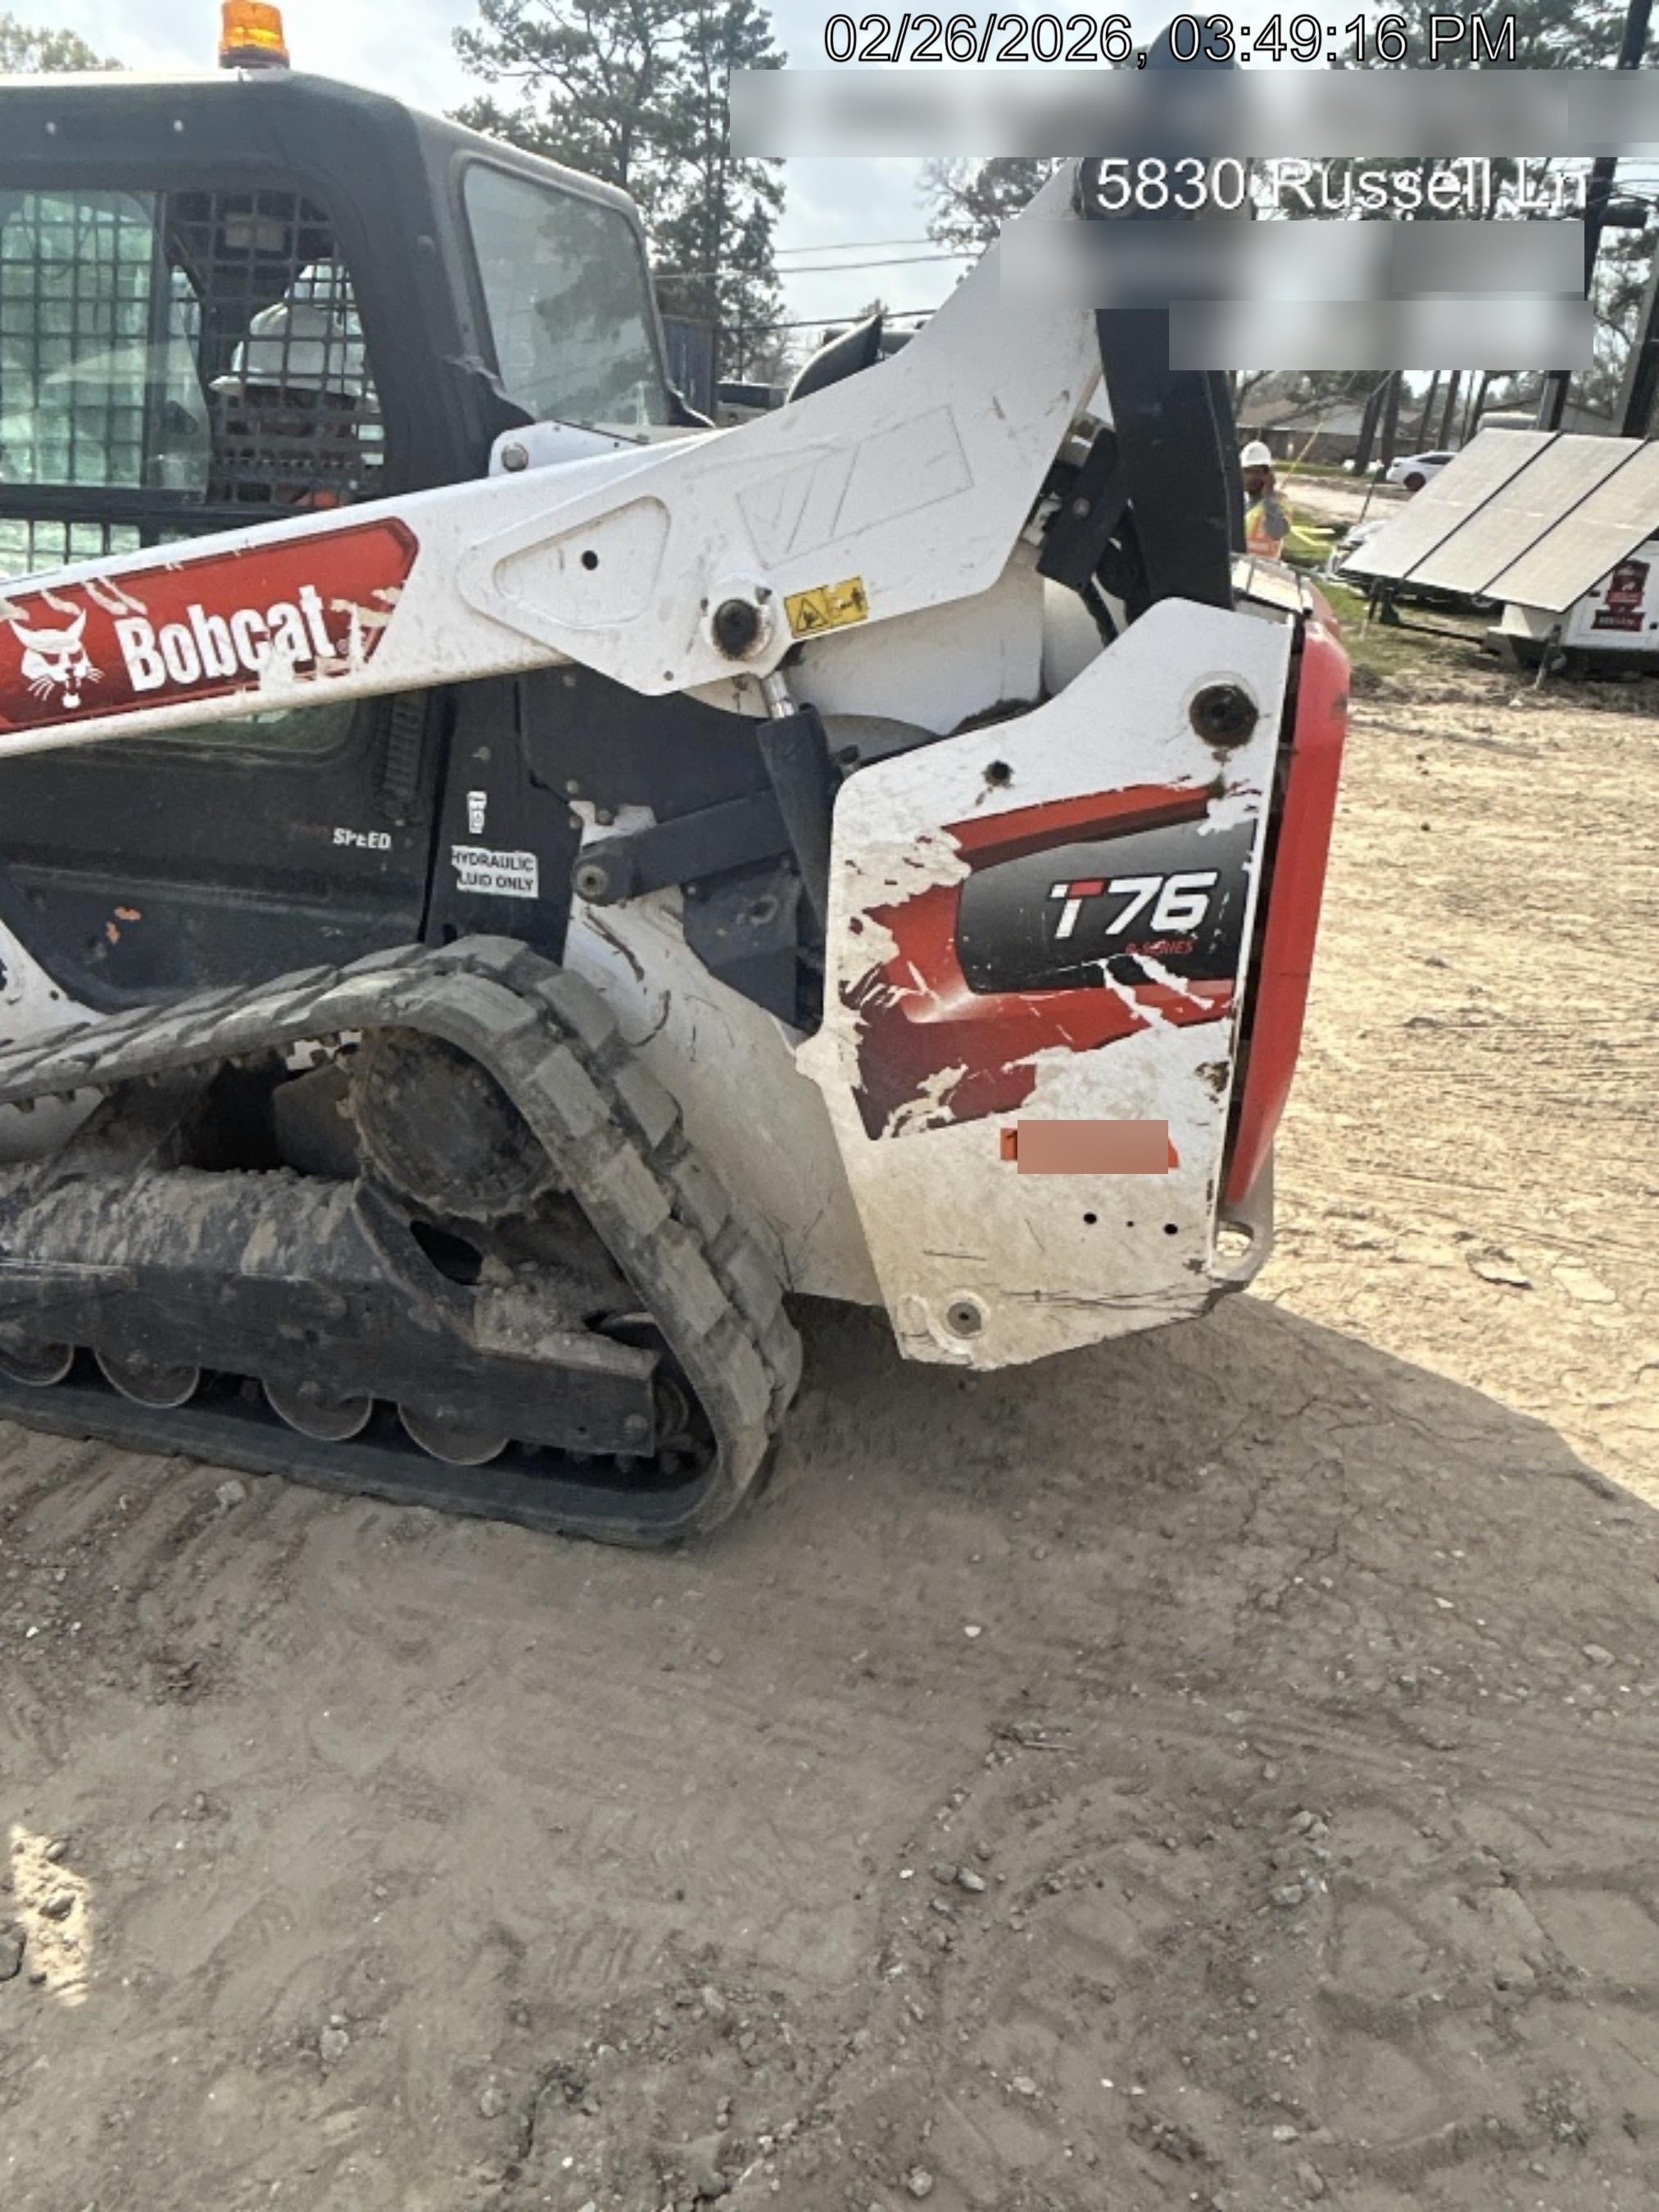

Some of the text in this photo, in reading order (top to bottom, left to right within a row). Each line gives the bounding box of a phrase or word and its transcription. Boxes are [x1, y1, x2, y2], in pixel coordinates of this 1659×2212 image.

[115, 584, 338, 692] Bobcat
[496, 874, 534, 891] ONLY
[1049, 871, 1218, 939] T76
